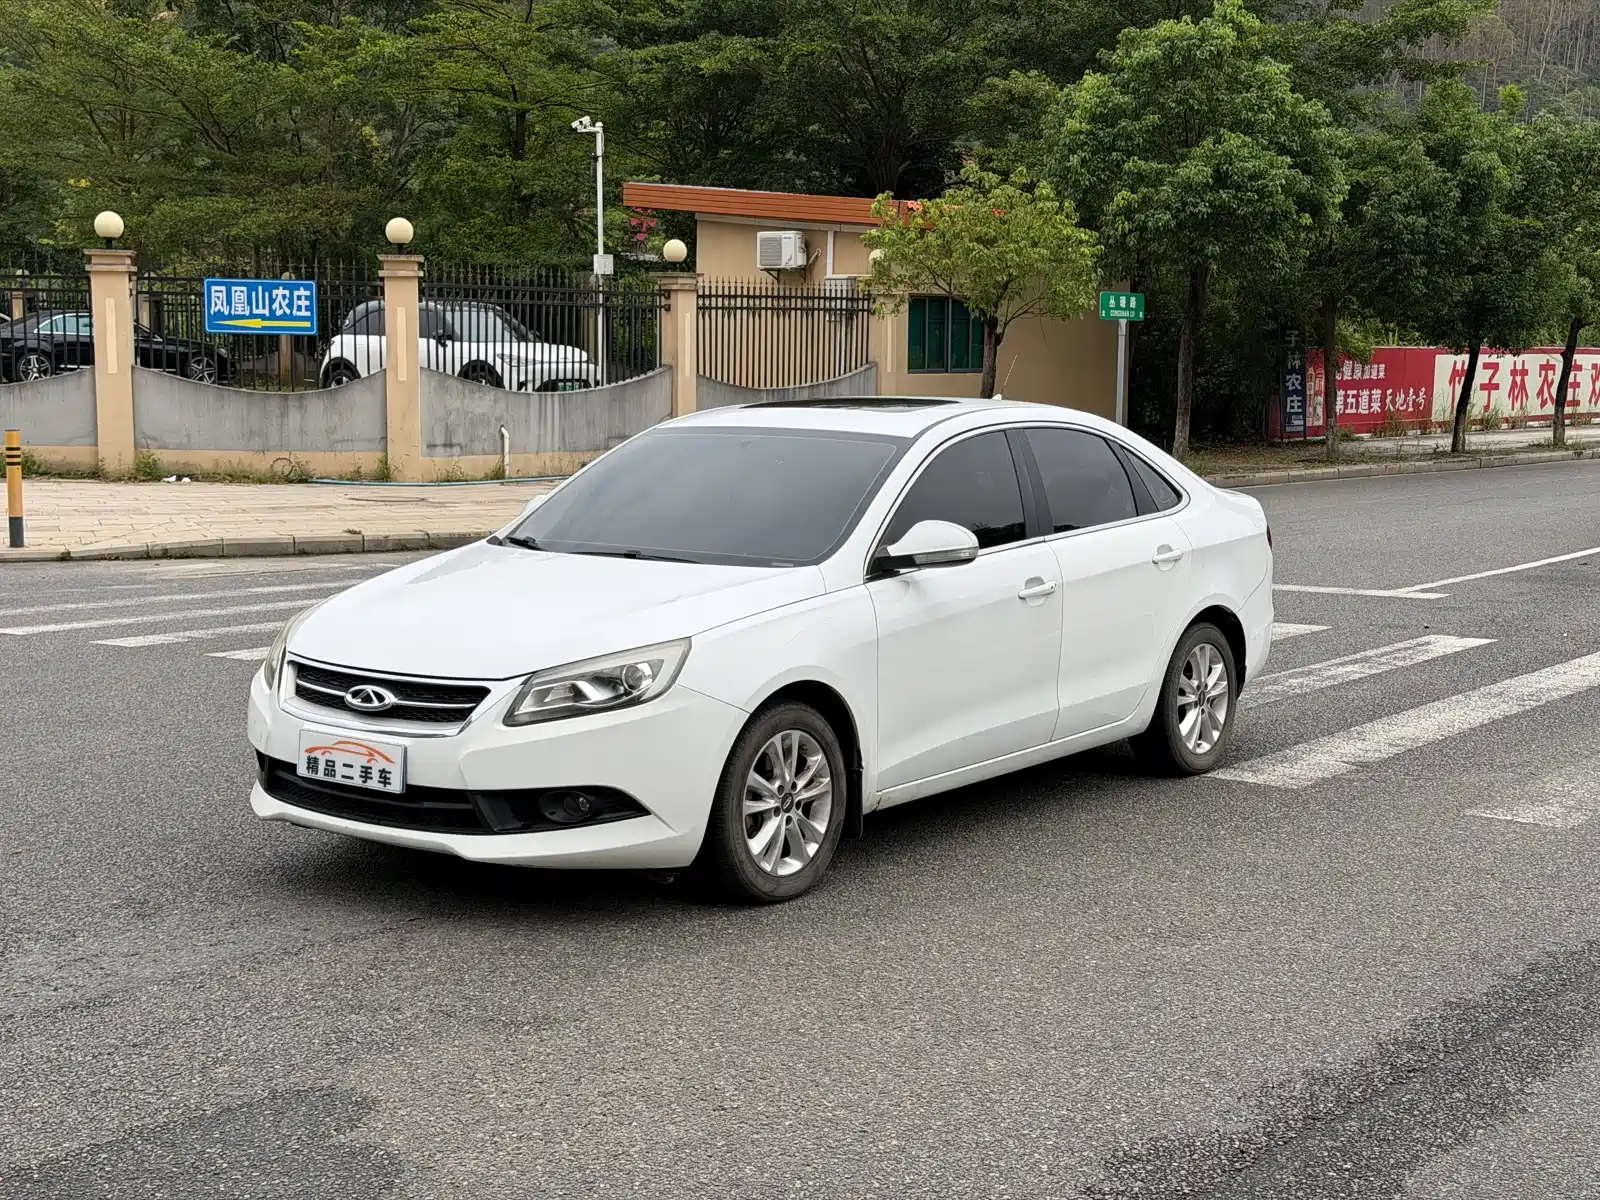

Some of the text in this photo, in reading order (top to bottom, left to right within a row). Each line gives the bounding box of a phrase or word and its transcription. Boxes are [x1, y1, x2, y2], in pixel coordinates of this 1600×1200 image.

[210, 286, 311, 317] 凤凰山农庄
[306, 755, 392, 787] 精品二手车
